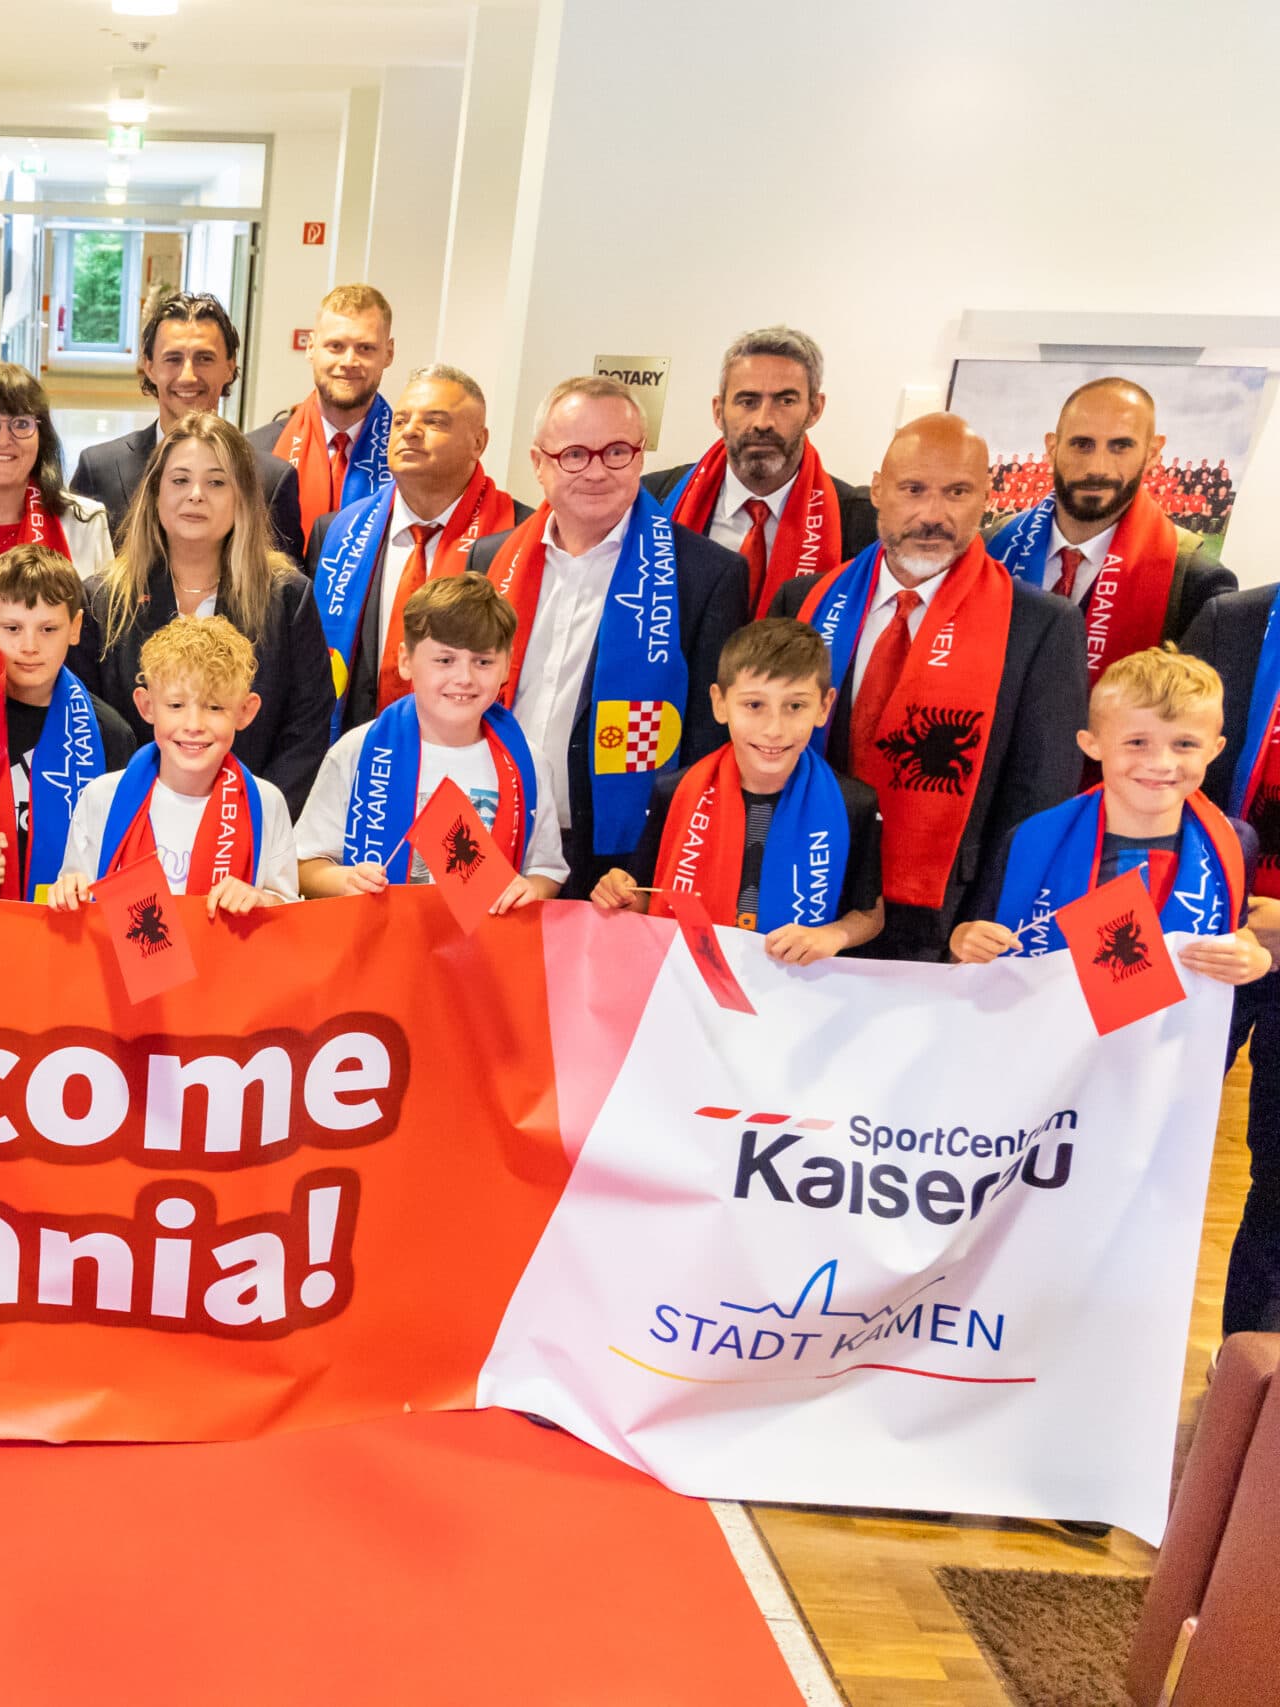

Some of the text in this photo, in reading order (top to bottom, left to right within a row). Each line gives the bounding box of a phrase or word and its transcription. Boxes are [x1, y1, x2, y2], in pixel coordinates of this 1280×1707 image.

[27, 486, 45, 543] ALBA
[795, 488, 824, 577] ALBANIE
[329, 558, 357, 617] STADT
[648, 515, 675, 663] STADT KAMEN
[1087, 553, 1123, 671] ALBANIEN
[69, 684, 94, 766] KAMEN
[211, 767, 238, 884] ALBANIE
[366, 747, 393, 831] KAMEN
[808, 831, 830, 924] KAMEN
[849, 1108, 1078, 1157] SportCentrum
[649, 1302, 1005, 1361] STADT KAMEN
